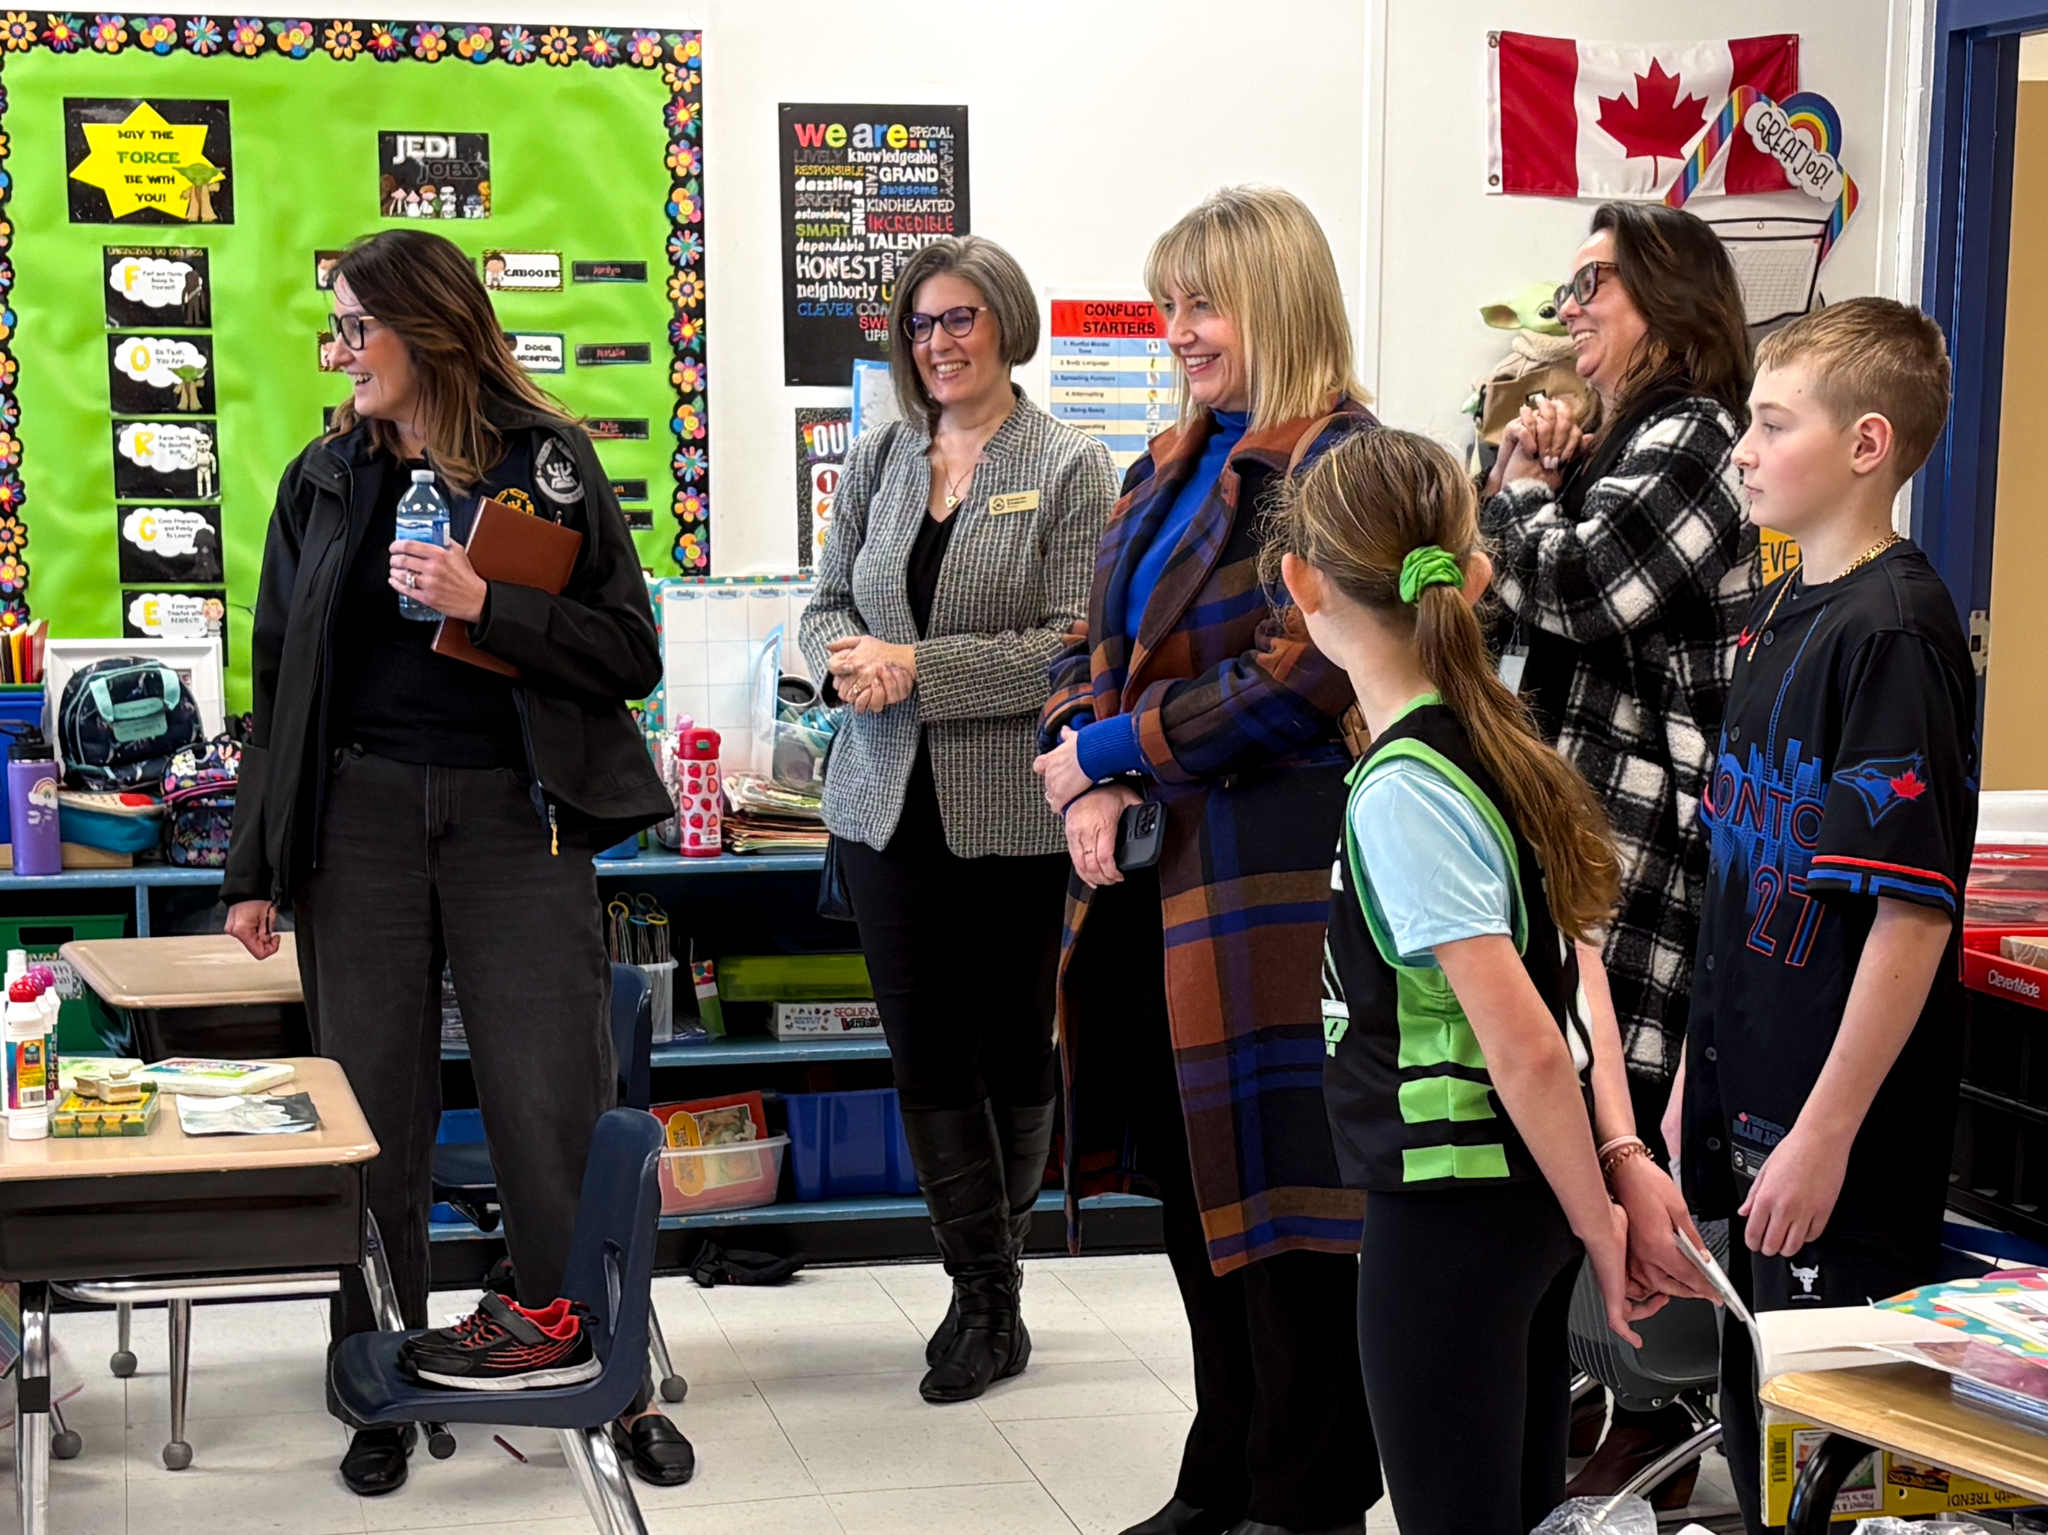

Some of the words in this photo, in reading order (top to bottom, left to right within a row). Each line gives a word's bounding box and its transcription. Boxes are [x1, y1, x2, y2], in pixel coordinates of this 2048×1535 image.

[117, 130, 145, 140] MAY
[150, 130, 174, 140] THE
[794, 123, 847, 148] we
[909, 126, 954, 139] SPECIAL
[116, 151, 181, 164] FORCE
[393, 134, 457, 165] JEDI
[794, 150, 844, 163] LIVELY
[847, 148, 938, 166] knowledgeable
[1756, 111, 1808, 164] GREAT
[1793, 152, 1834, 191] JOB!
[794, 165, 865, 177] RESPONSIBLE
[879, 167, 939, 183] GRAND
[940, 140, 954, 197] HAPPY
[124, 174, 143, 184] BE
[146, 174, 175, 184] WITH
[795, 176, 863, 196] dazzling
[865, 166, 878, 196] FAIR
[135, 193, 166, 203] YOU!
[879, 185, 938, 196] awesome
[794, 194, 851, 208] BRIGHT
[866, 199, 955, 213] KINDHEARTED
[794, 207, 851, 223] astonishing
[852, 198, 866, 236] FINE
[868, 214, 955, 232] INCREDIBLE
[795, 224, 850, 238] SMART
[796, 238, 866, 255] dependable
[867, 232, 953, 250] TALENT
[504, 268, 560, 278] CABOOSE
[796, 254, 880, 279] HONEST
[881, 252, 895, 283] COOL
[124, 265, 140, 292] F
[796, 281, 878, 302] neighborly
[797, 302, 854, 316] CLEVER
[1084, 303, 1154, 317] CONFLICT
[1083, 322, 1156, 334] STARTERS
[525, 344, 553, 352] DOOR
[130, 345, 151, 372] O
[134, 432, 154, 457] R
[824, 471, 832, 492] 1
[139, 516, 158, 542] C
[144, 600, 162, 627] E
[1746, 864, 1826, 968] 27
[1988, 969, 2041, 999] CleverMade
[1947, 1491, 1992, 1507] TREND!
